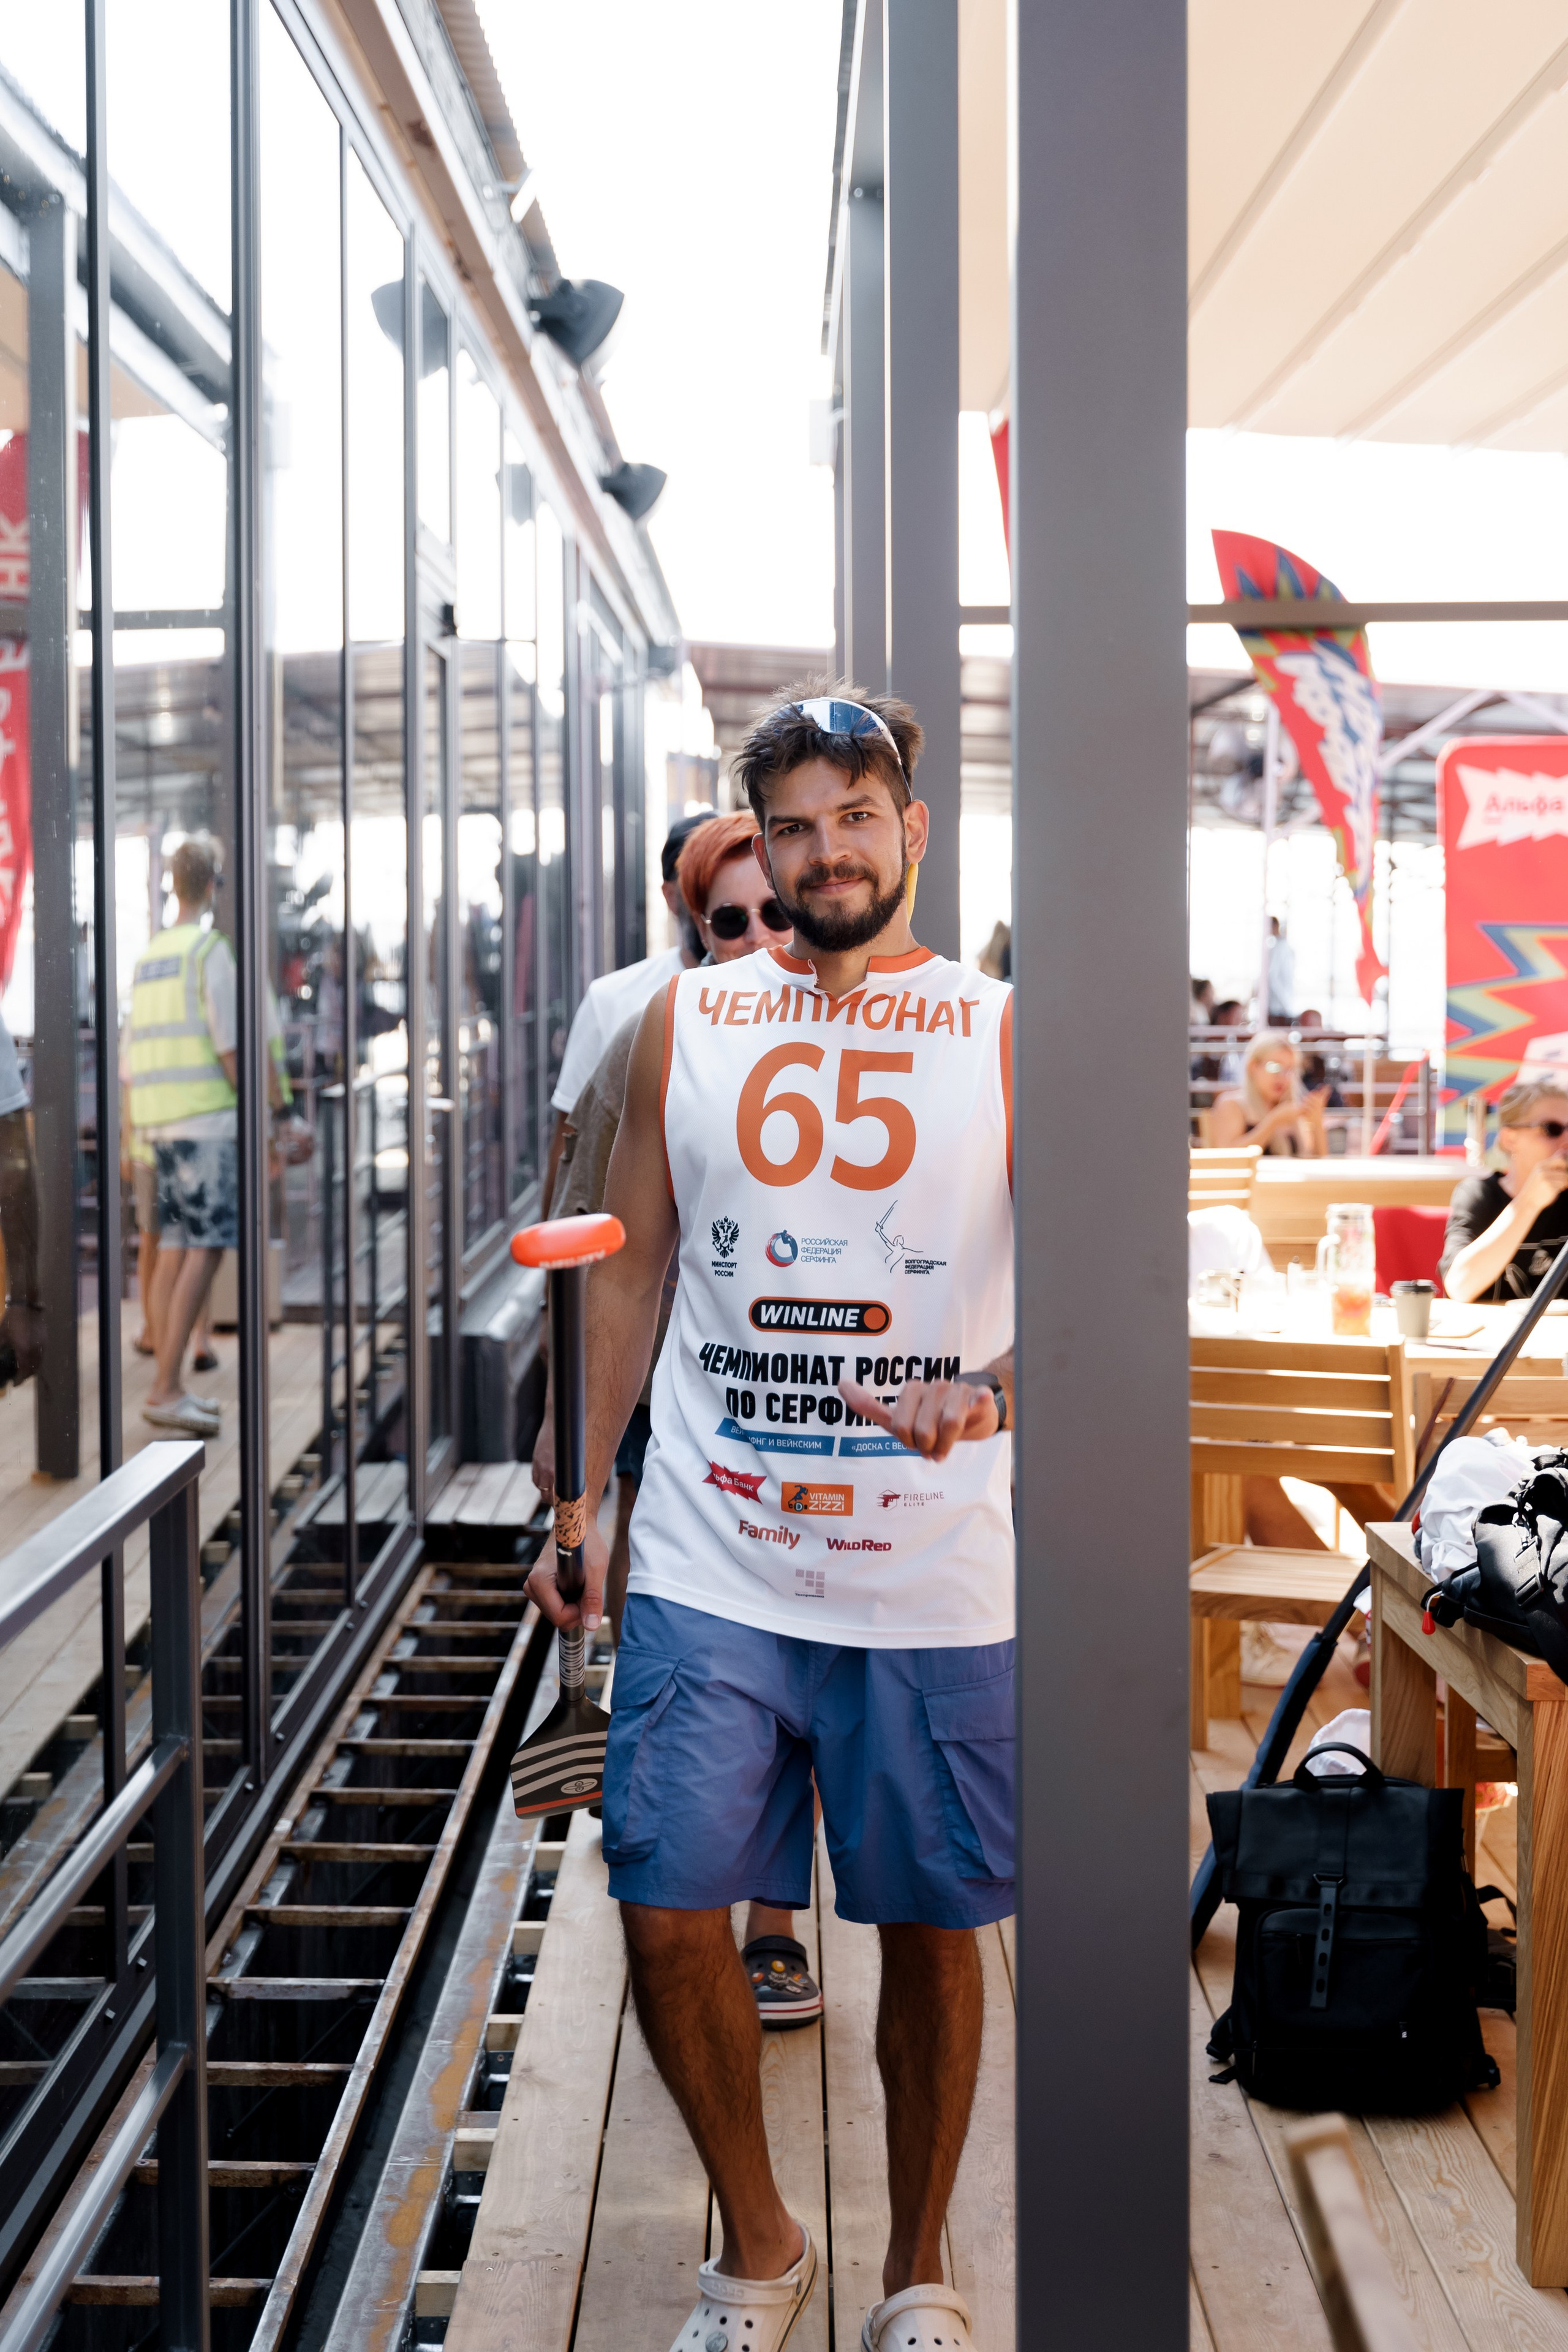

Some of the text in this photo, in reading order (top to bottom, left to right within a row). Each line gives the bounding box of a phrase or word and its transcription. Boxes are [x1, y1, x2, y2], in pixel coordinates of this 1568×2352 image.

[698, 984, 980, 1037] ЧЕМПИОНАТ
[736, 1042, 916, 1191] 65
[761, 1305, 859, 1327] WINLINE
[699, 1343, 960, 1386] ЧЕМПИОНАТ РОССИИ
[726, 1387, 756, 1419] ПО
[777, 1439, 821, 1449] ВЕЙКСКИМ
[851, 1442, 883, 1452] «ДОСКА
[734, 1477, 754, 1492] Банк
[904, 1491, 944, 1501] FIRELINE
[739, 1519, 801, 1550] Family
